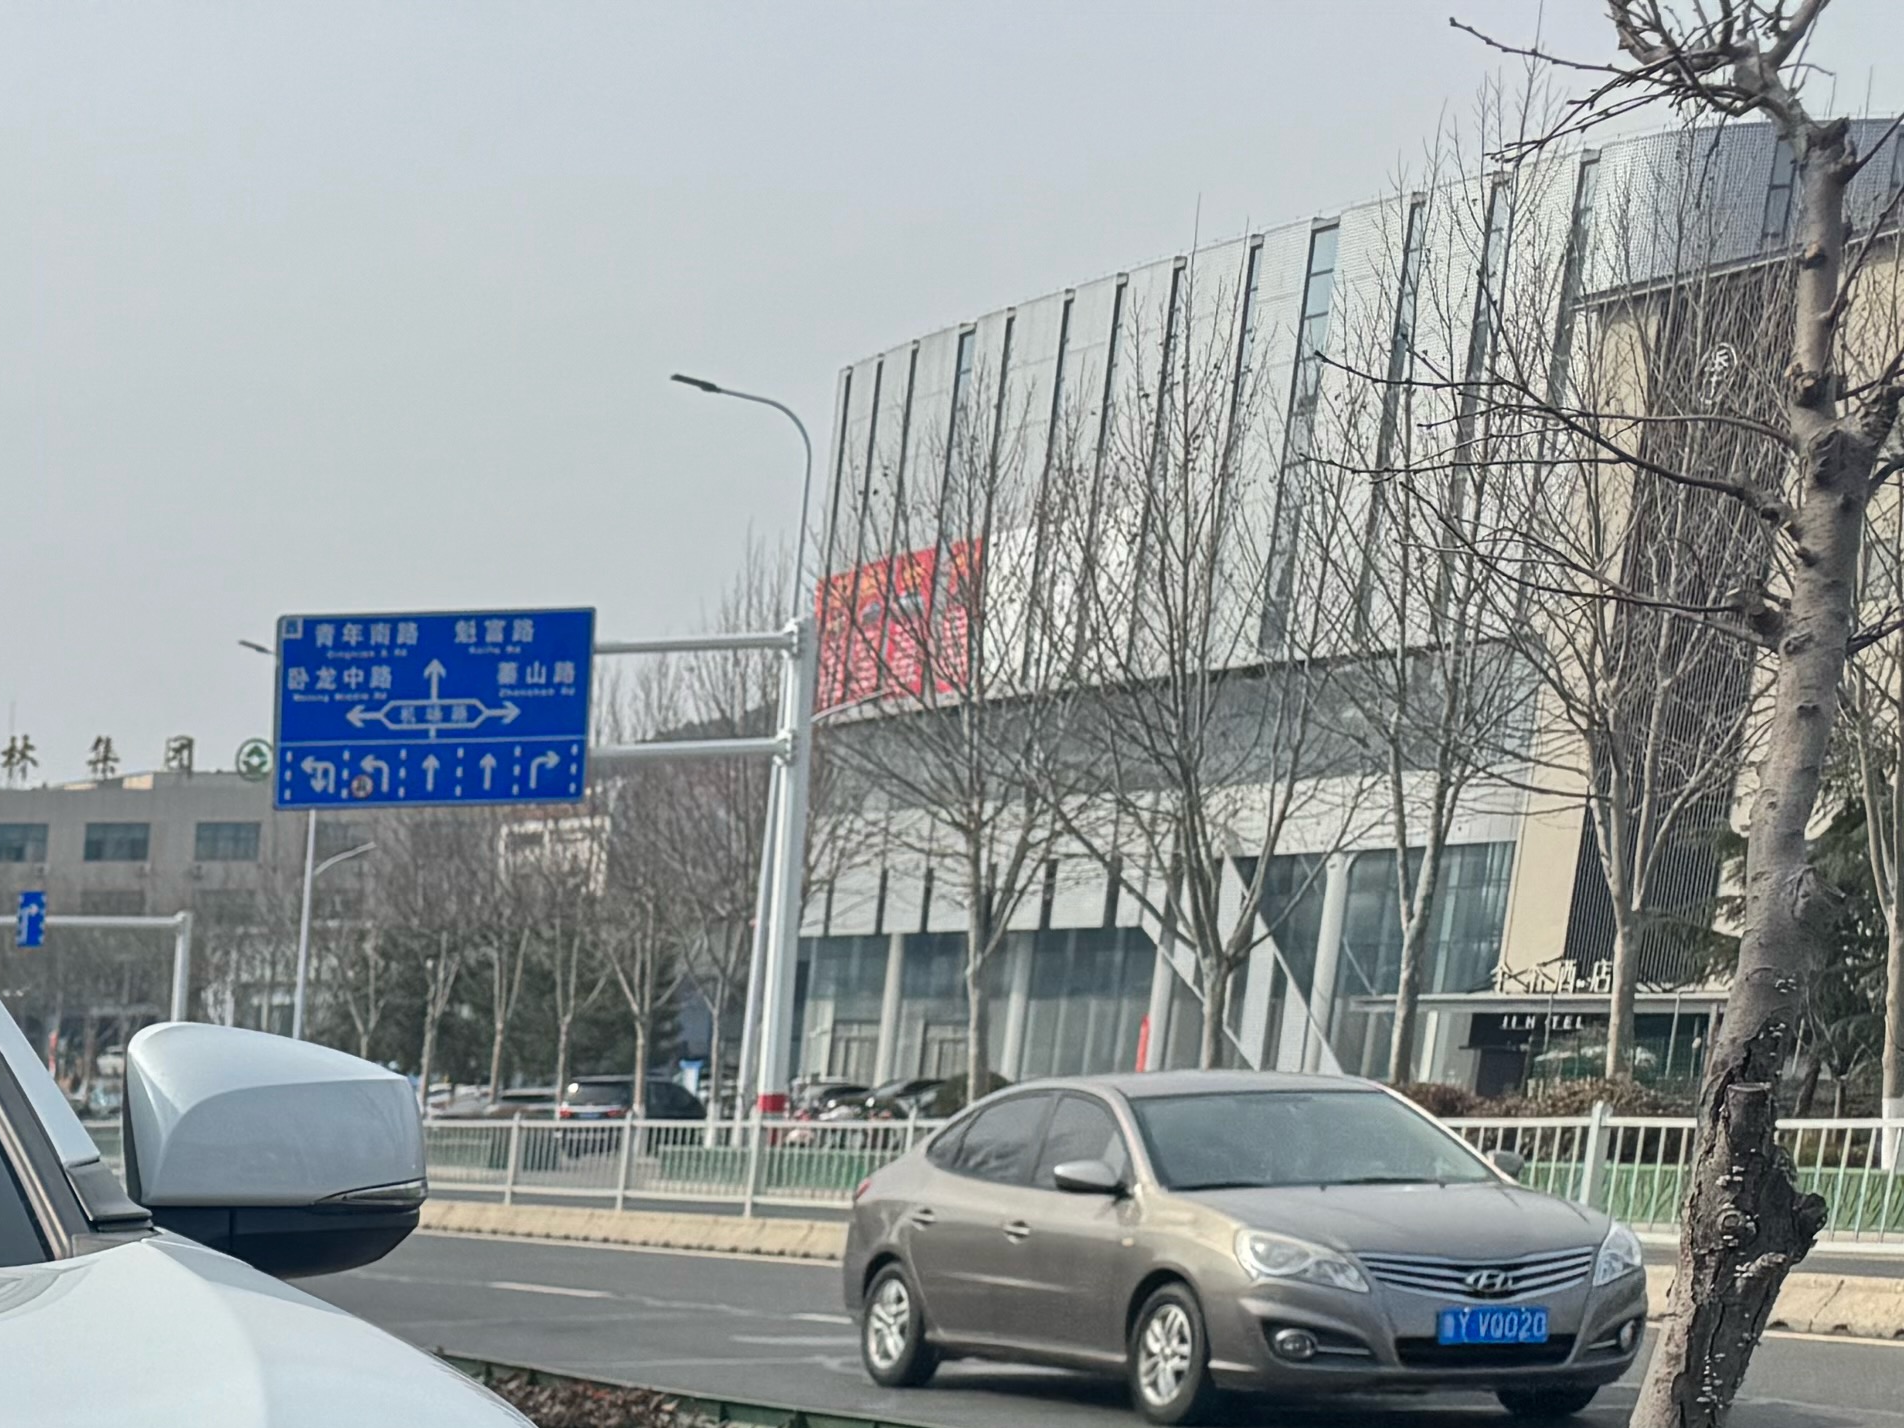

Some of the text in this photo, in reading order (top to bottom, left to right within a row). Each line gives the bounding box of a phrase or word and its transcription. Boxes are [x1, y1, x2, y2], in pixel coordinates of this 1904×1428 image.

[315, 621, 419, 648] 青年南路
[287, 664, 392, 691] 卧龙中路
[1525, 1014, 1583, 1030] HTEL
